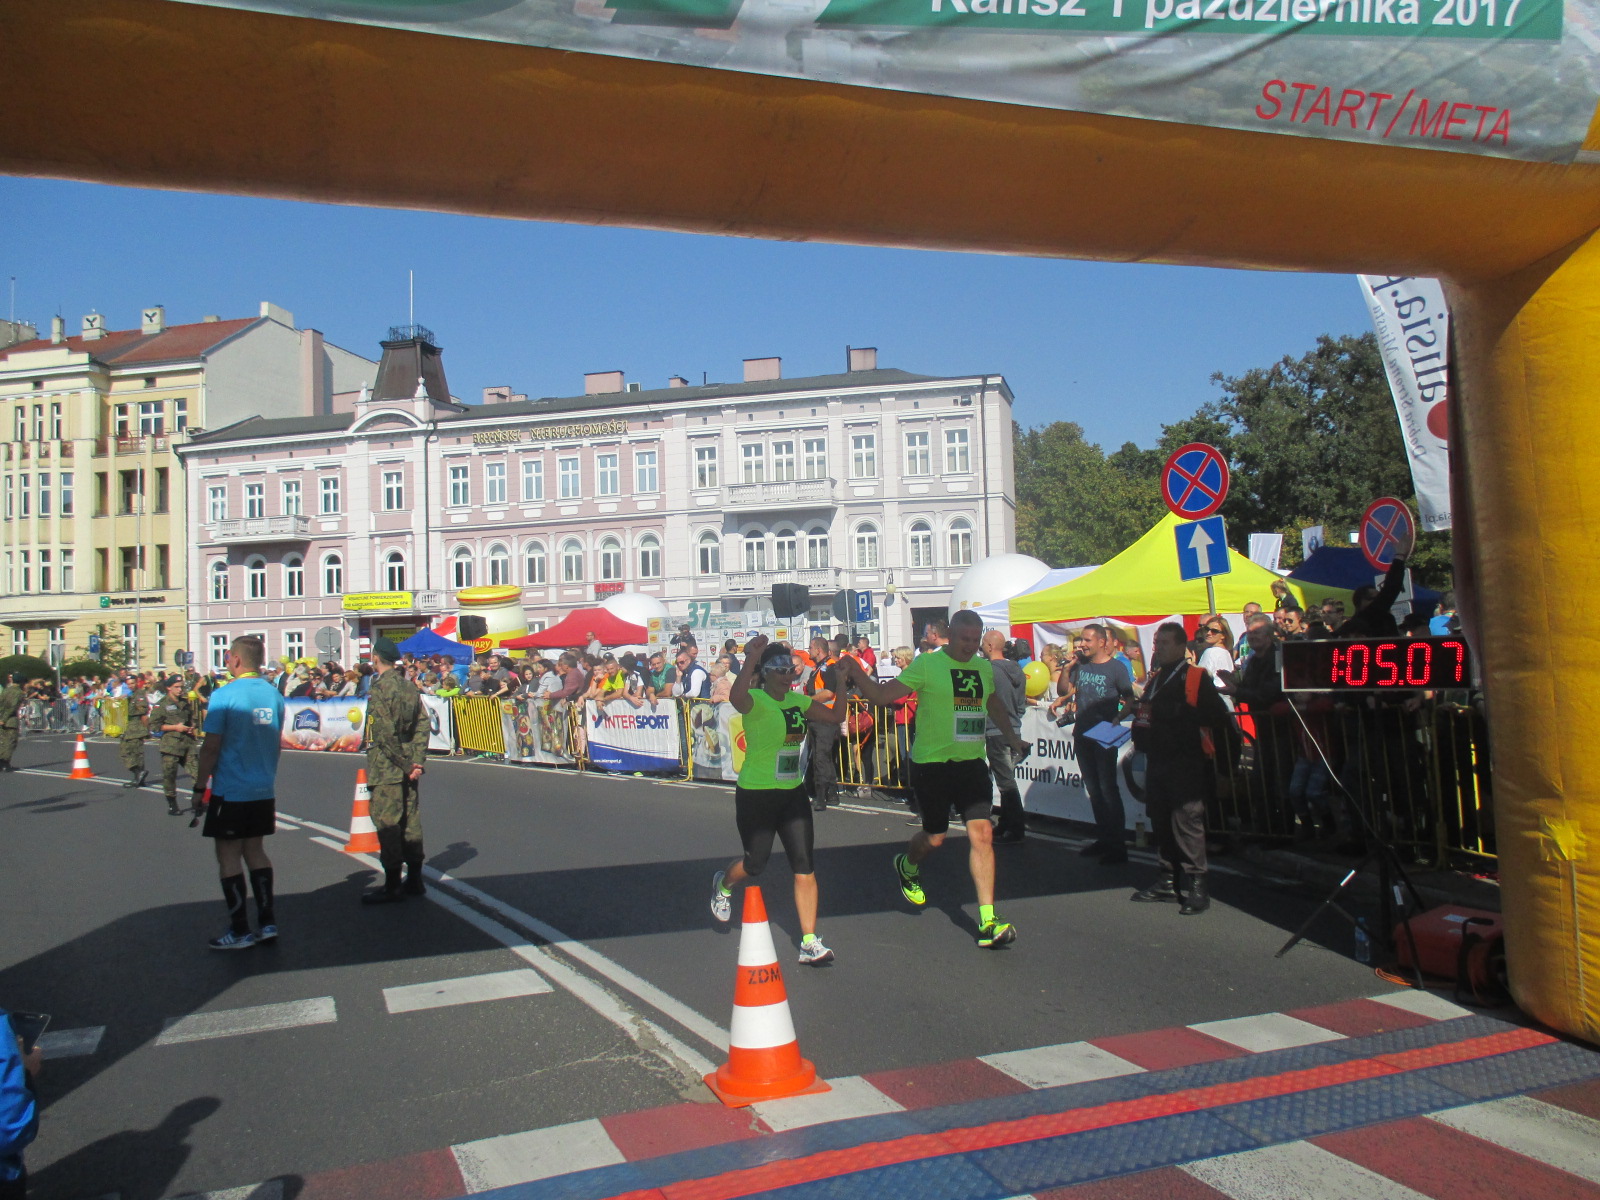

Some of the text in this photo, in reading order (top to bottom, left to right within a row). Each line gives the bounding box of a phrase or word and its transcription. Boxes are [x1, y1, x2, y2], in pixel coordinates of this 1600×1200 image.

[1432, 0, 1520, 27] 2017
[1255, 79, 1511, 146] START/META
[530, 419, 629, 440] NIERUCHOMOŚCI
[687, 602, 712, 628] 37
[960, 698, 979, 706] night
[604, 715, 669, 729] INTERSPORT
[961, 719, 983, 732] 219
[1037, 737, 1076, 761] BMW
[748, 967, 781, 985] ZDM
